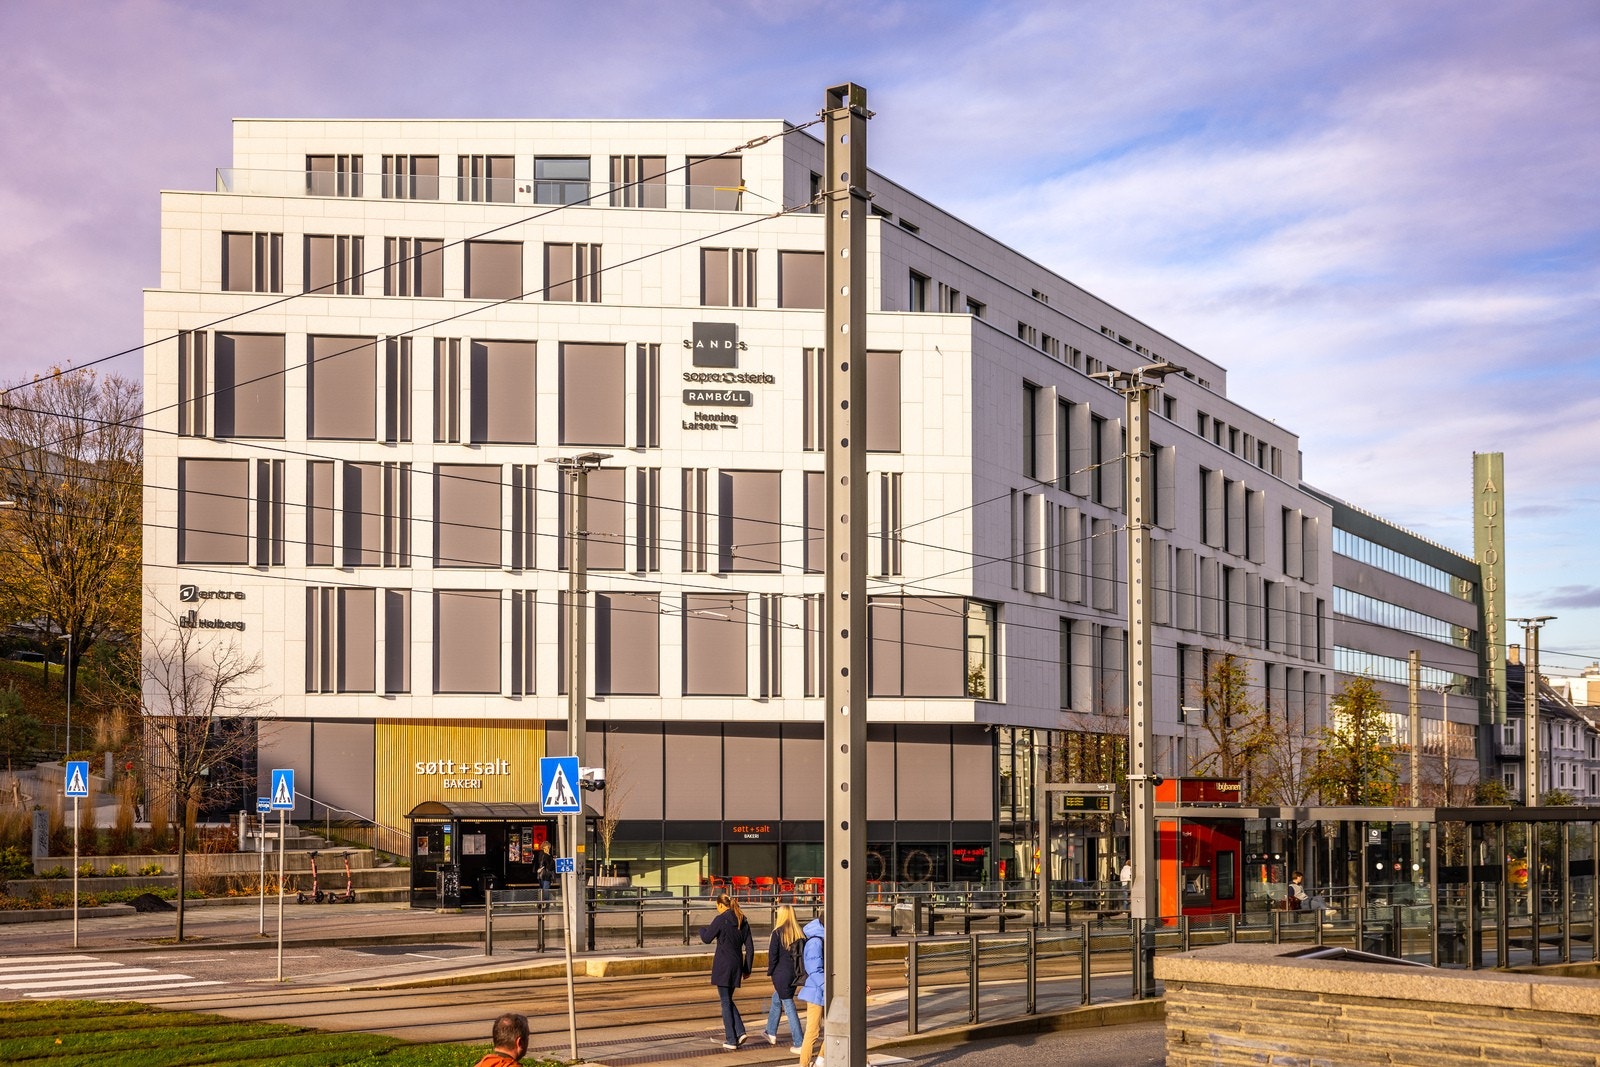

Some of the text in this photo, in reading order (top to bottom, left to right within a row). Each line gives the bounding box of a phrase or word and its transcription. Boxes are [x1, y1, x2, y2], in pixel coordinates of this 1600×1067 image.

[683, 339, 748, 351] SANDS
[682, 372, 775, 384] sopra steria
[694, 411, 738, 424] Henning
[682, 420, 719, 430] Larsen
[199, 618, 246, 632] Holberg
[416, 759, 455, 775] søtt
[474, 758, 509, 775] salt
[443, 779, 482, 789] BAKERI
[755, 825, 770, 833] salt
